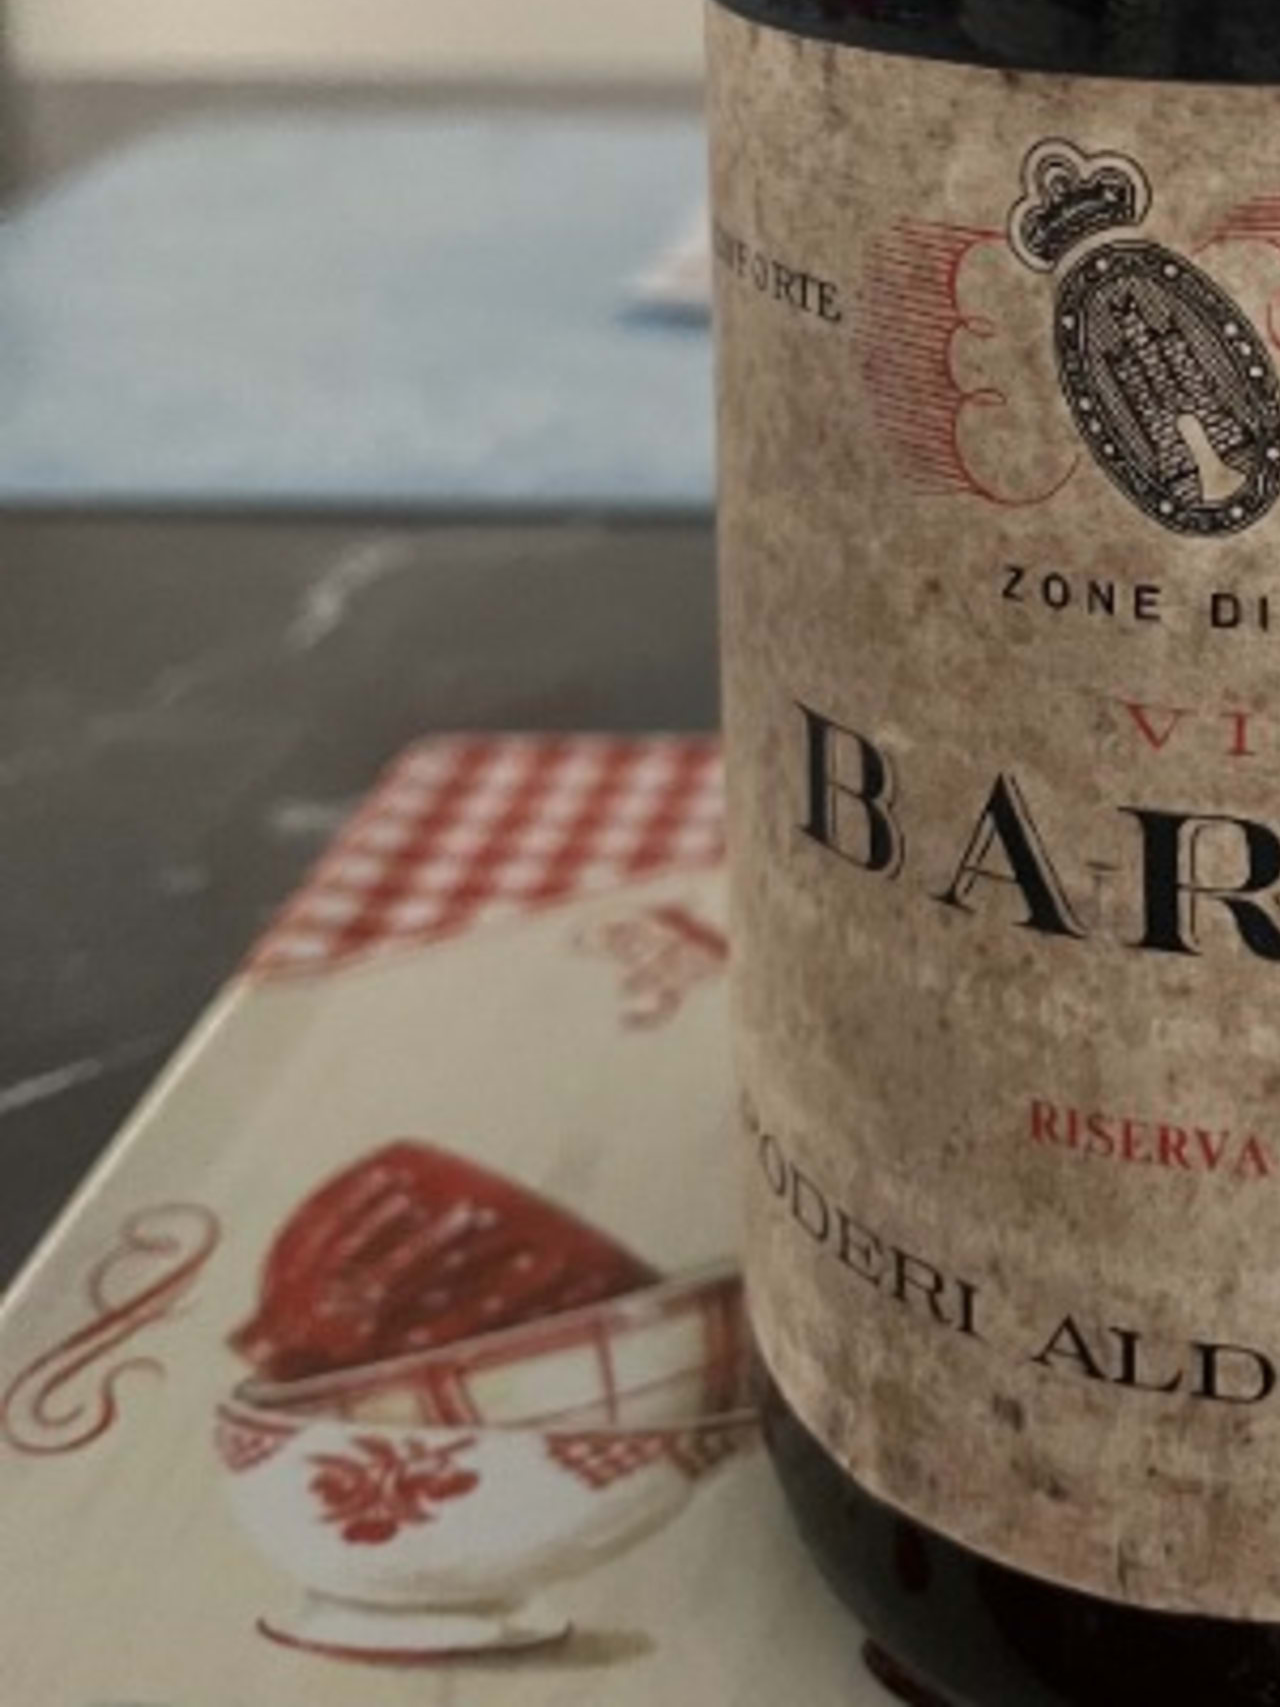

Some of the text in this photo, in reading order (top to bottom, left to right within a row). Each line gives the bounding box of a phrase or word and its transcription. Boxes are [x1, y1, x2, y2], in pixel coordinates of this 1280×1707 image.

[1001, 567, 1162, 621] ZONE
[1210, 593, 1270, 631] DI
[1029, 1098, 1270, 1176] RISERVA
